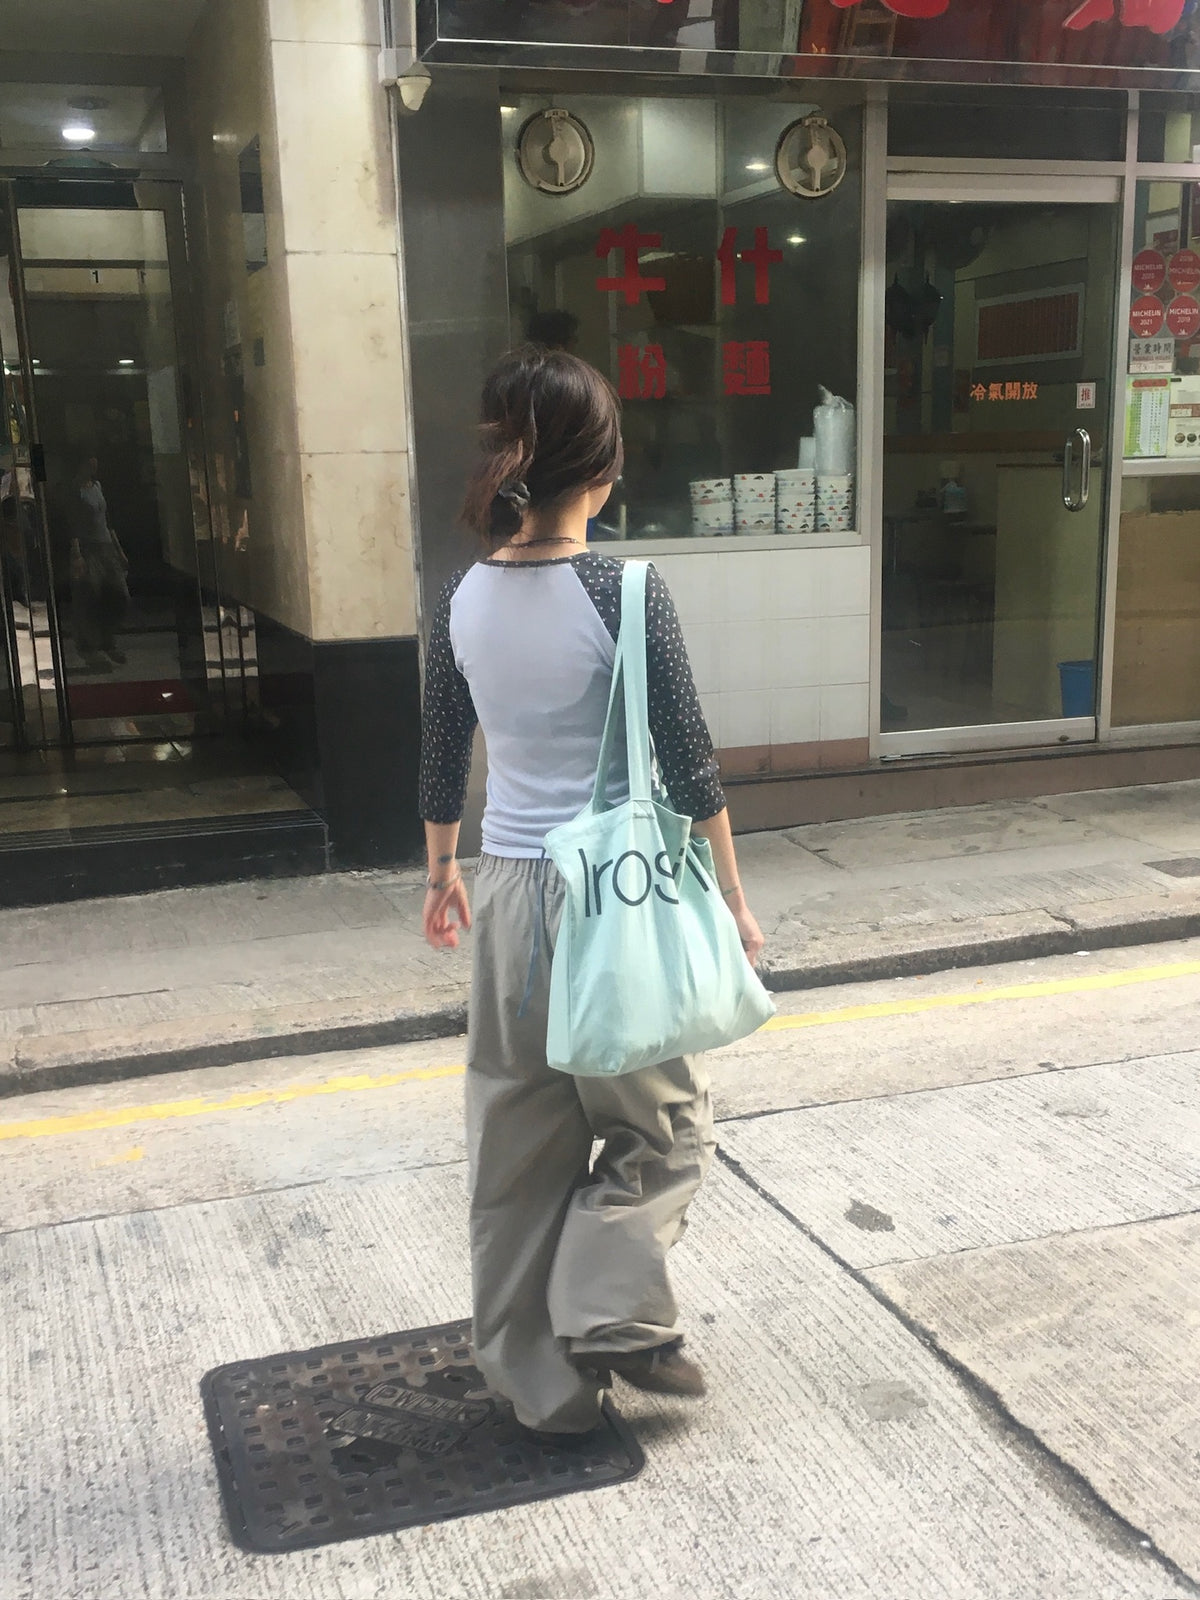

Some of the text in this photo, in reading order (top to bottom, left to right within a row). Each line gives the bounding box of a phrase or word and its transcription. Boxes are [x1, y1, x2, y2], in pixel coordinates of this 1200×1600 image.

[595, 223, 783, 305] 牛什
[92, 270, 98, 283] 1
[1133, 342, 1172, 355] 營業時間
[618, 341, 771, 399] 粉麵
[970, 382, 1038, 401] 冷氣開放
[1081, 387, 1091, 401] 推
